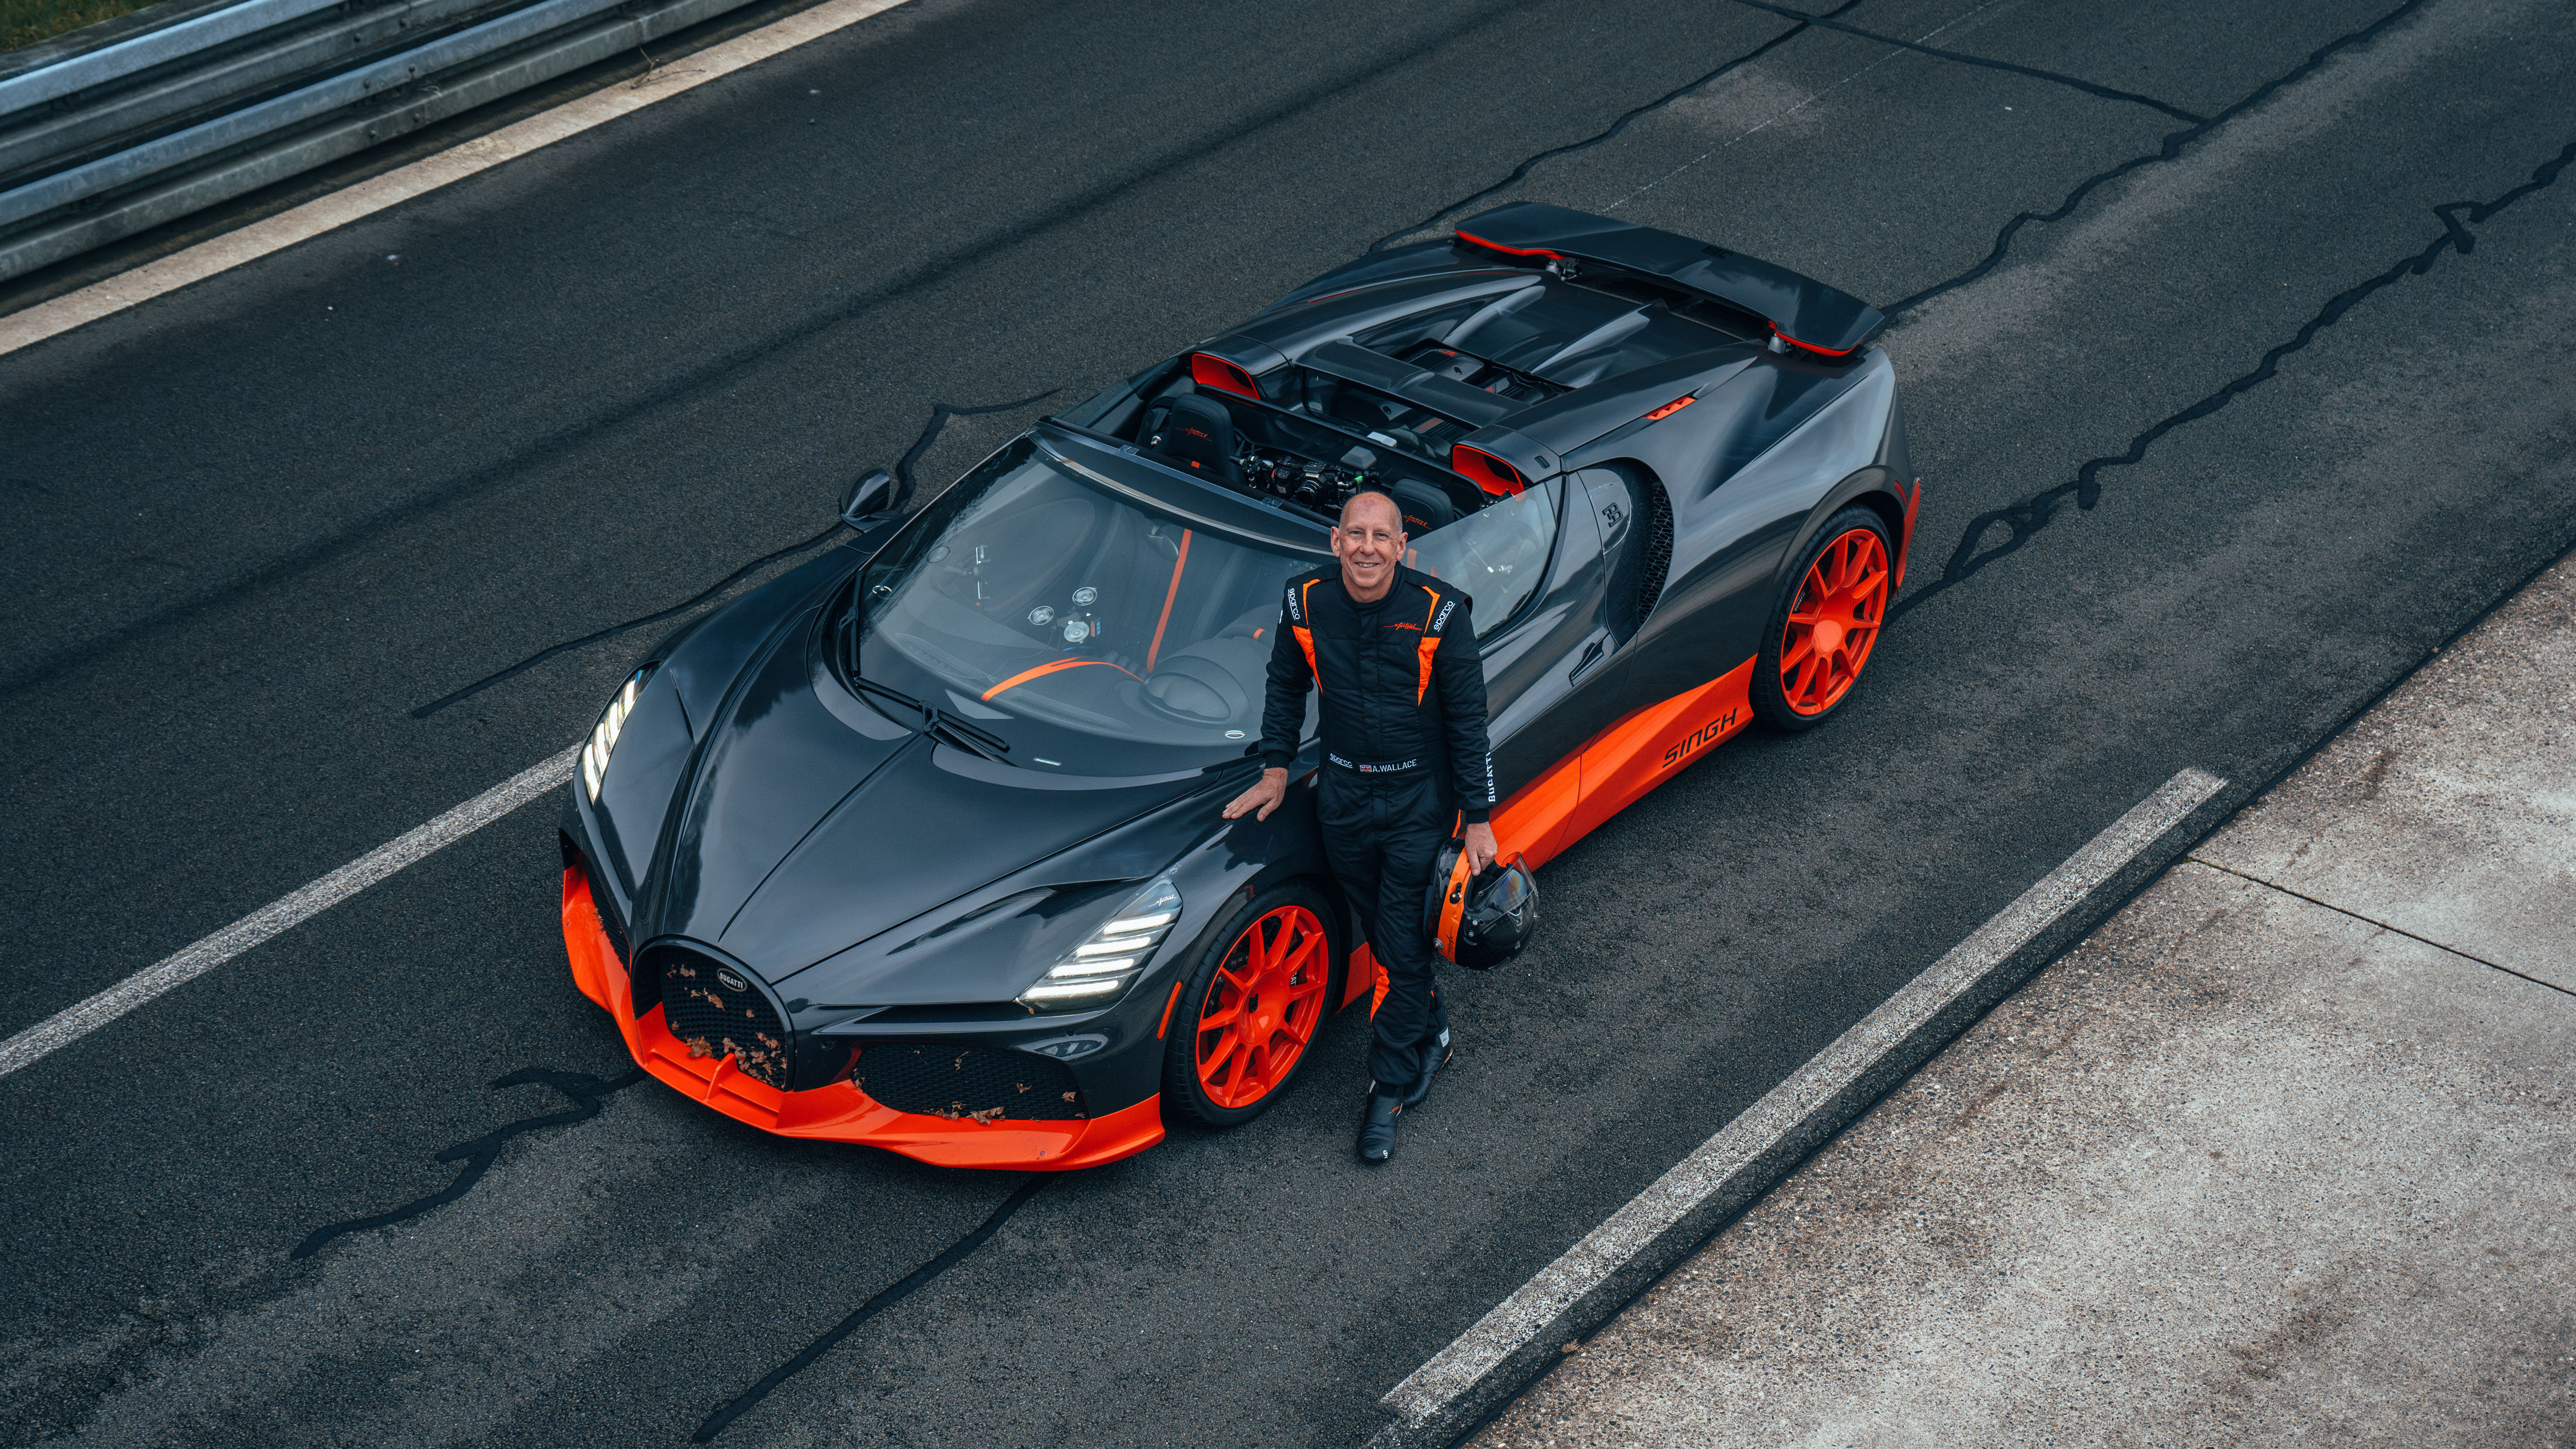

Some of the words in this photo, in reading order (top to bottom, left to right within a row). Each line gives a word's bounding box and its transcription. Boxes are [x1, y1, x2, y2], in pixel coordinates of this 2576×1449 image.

[1287, 588, 1300, 621] sparco
[1433, 601, 1456, 632] sparco
[1383, 621, 1423, 631] Mistral
[1329, 753, 1353, 769] sparco
[1372, 759, 1417, 773] A.WALLACE
[1486, 751, 1496, 803] BUGATTI
[719, 972, 743, 989] BUGATTI
